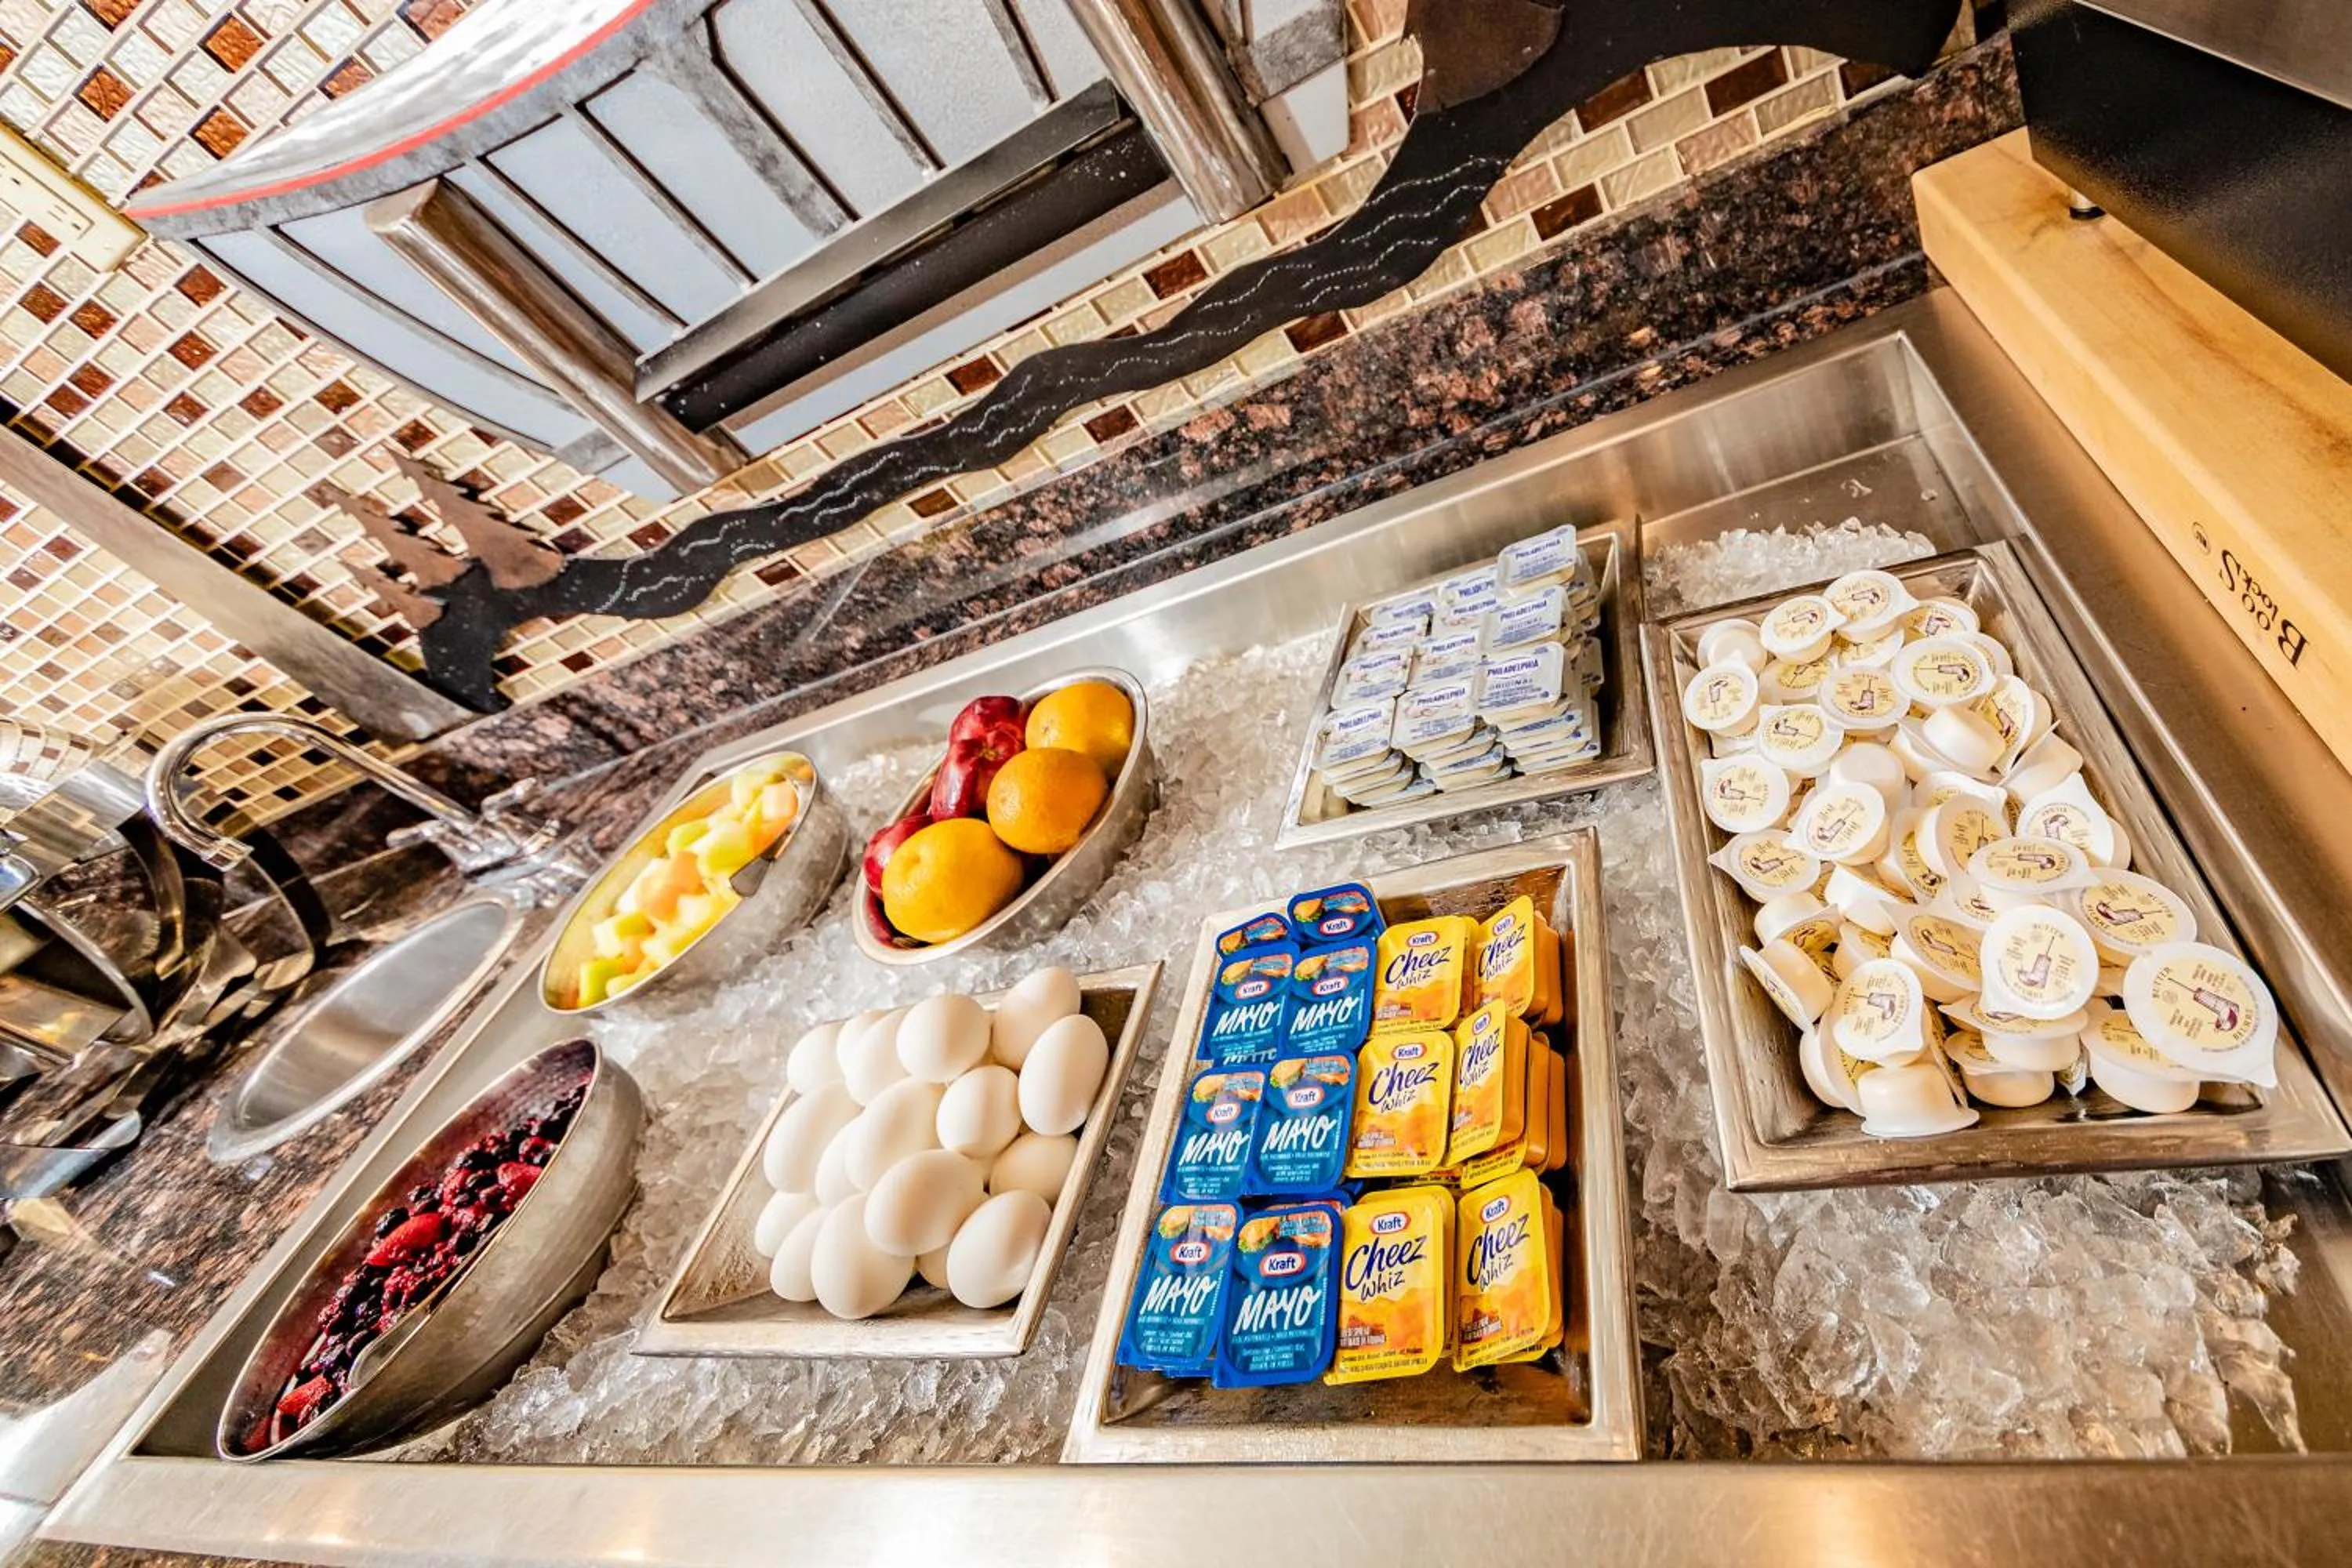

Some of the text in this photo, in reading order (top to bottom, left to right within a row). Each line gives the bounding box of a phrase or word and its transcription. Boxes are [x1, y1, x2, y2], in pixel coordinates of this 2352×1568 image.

[1487, 659, 1539, 677] PHILADELPHIA
[1417, 688, 1465, 705] PHILADELPHIA
[1326, 920, 1347, 932] Kraft
[1496, 918, 1513, 934] Kraft
[1411, 935, 1433, 945] Kraft
[1478, 923, 1526, 978] Cheez
[1385, 946, 1451, 984] Cheez
[1243, 982, 1263, 994] Kraft
[1319, 981, 1341, 992] Kraft
[1212, 1002, 1279, 1036] MAYO
[1290, 996, 1359, 1034] MAYO
[1398, 1046, 1419, 1058] Kraft
[1459, 1028, 1500, 1087] Cheez
[1368, 1062, 1440, 1105] Cheez
[1294, 1091, 1316, 1103] Kraft
[1214, 1107, 1234, 1119] Kraft
[1261, 1114, 1337, 1153] MAYO
[1178, 1130, 1250, 1166] MAYO
[1486, 1201, 1505, 1219] Kraft
[1377, 1218, 1403, 1231] Kraft
[1178, 1246, 1202, 1259] Kraft
[1467, 1214, 1531, 1287] Cheez
[1268, 1257, 1296, 1272] Kraft
[1345, 1235, 1428, 1291] Cheez
[1139, 1276, 1218, 1316] MAYO
[1232, 1285, 1322, 1335] MAYO
